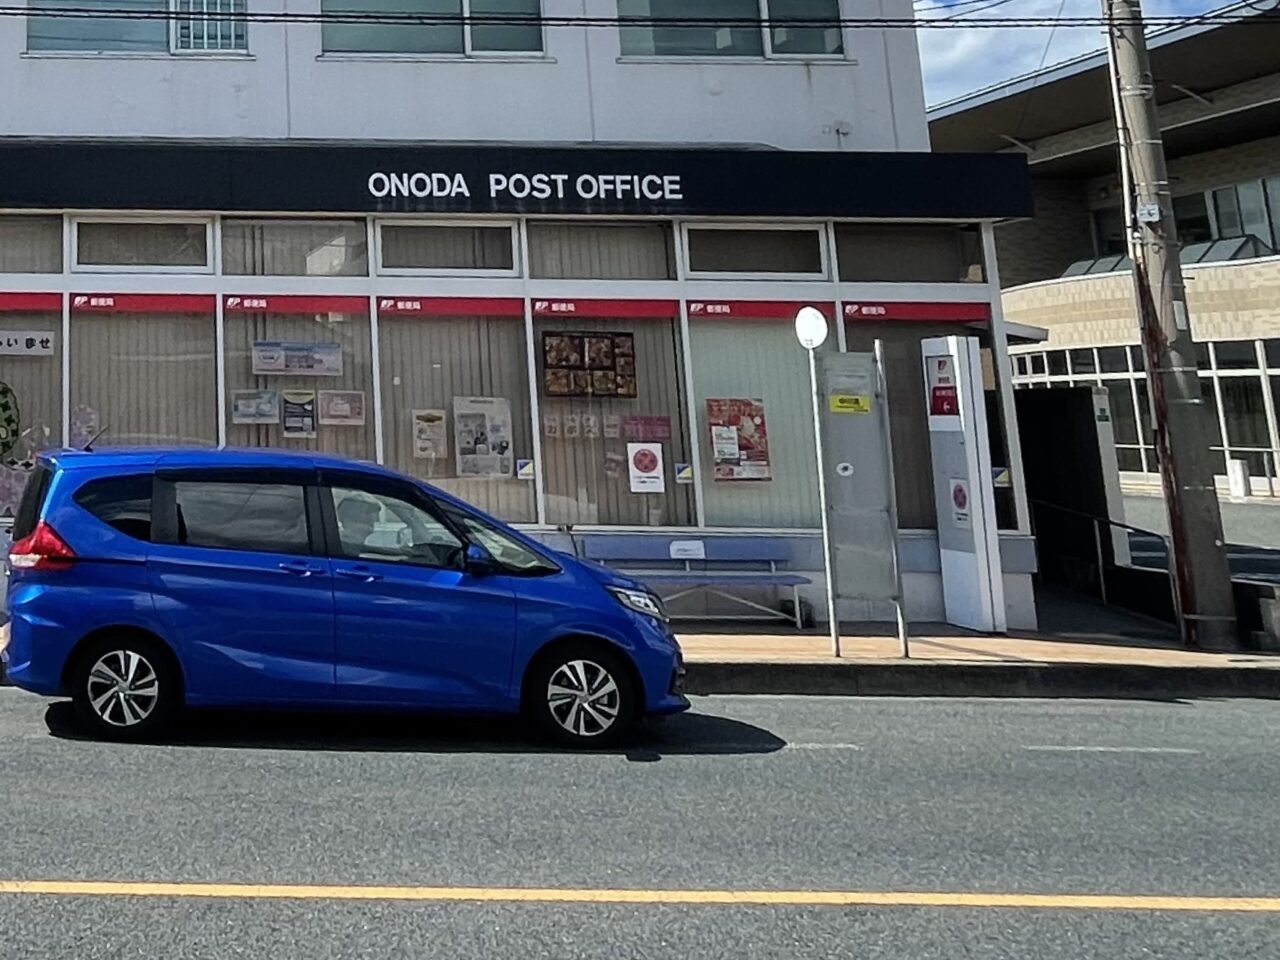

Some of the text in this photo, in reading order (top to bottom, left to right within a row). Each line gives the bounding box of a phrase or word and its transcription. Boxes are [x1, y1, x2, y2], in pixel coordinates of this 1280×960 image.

[368, 173, 683, 200] ONODA POST OFFICE
